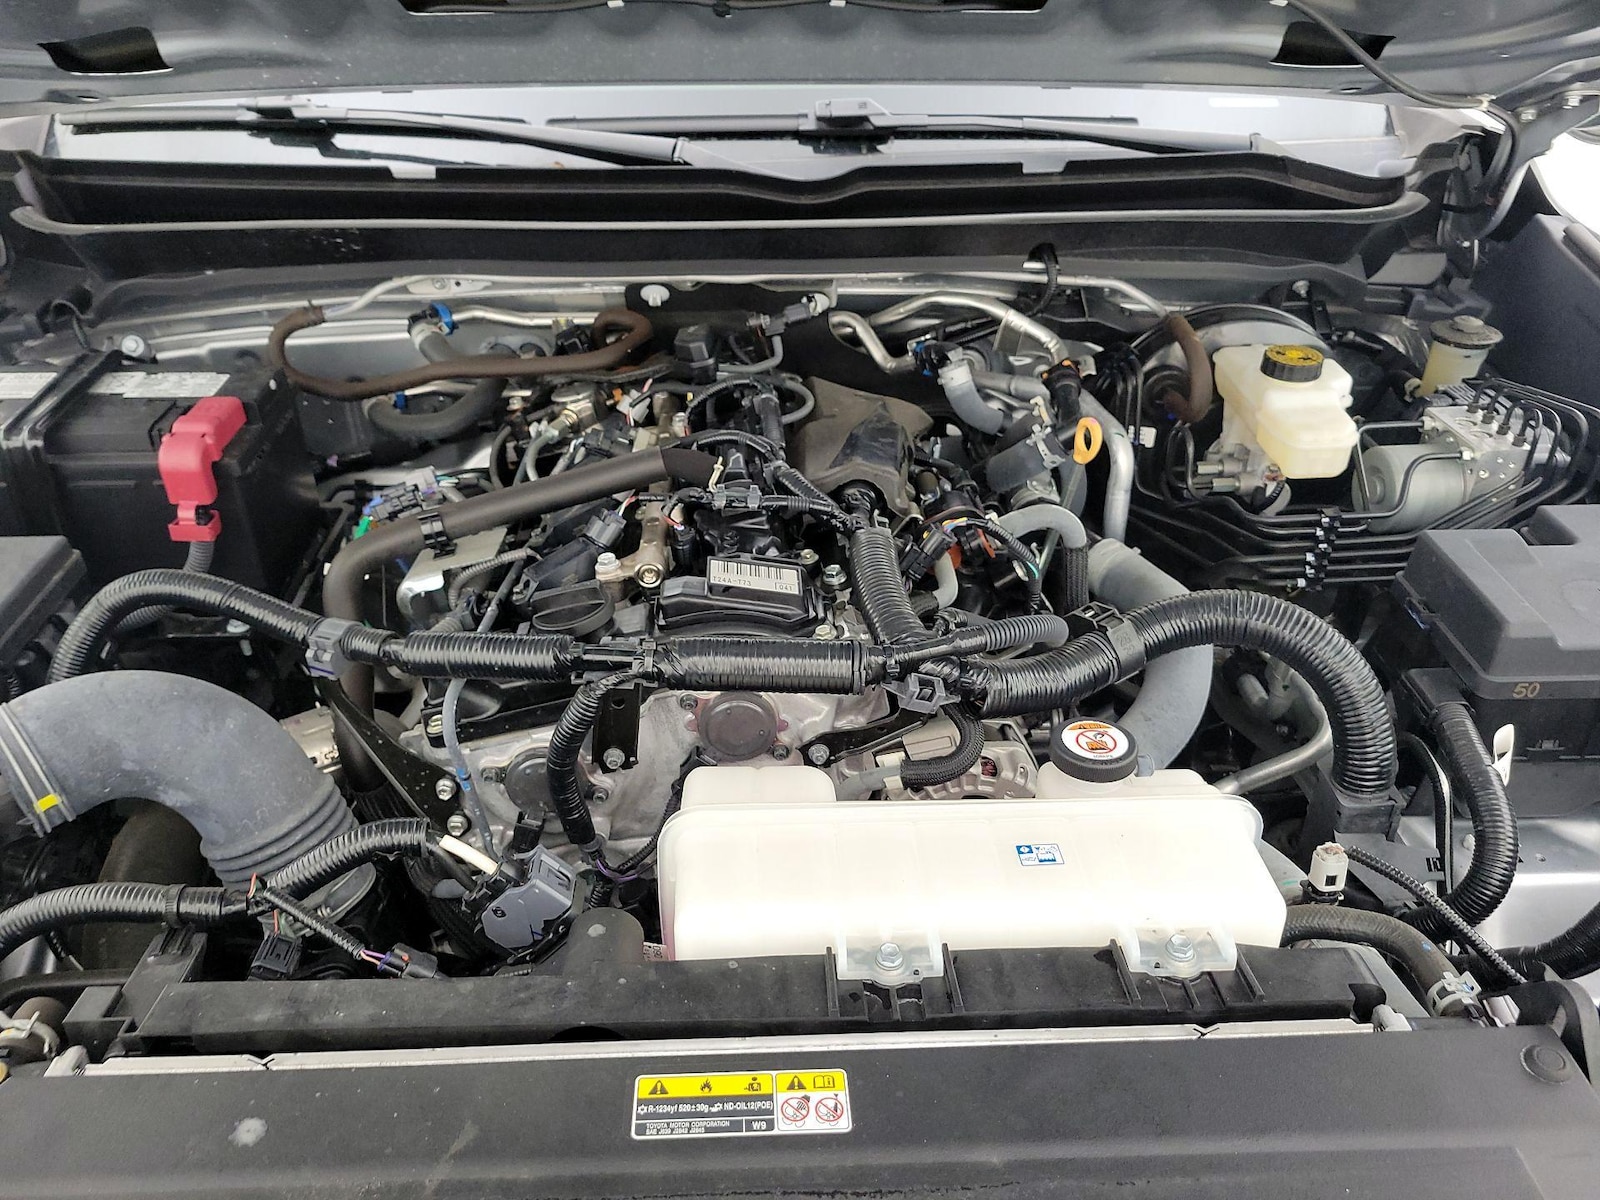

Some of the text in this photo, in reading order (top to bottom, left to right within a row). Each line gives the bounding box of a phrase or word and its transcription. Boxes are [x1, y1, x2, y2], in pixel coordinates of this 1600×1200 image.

[1512, 682, 1541, 698] 50
[647, 1104, 678, 1114] R-1234yf
[751, 1121, 767, 1130] W9
